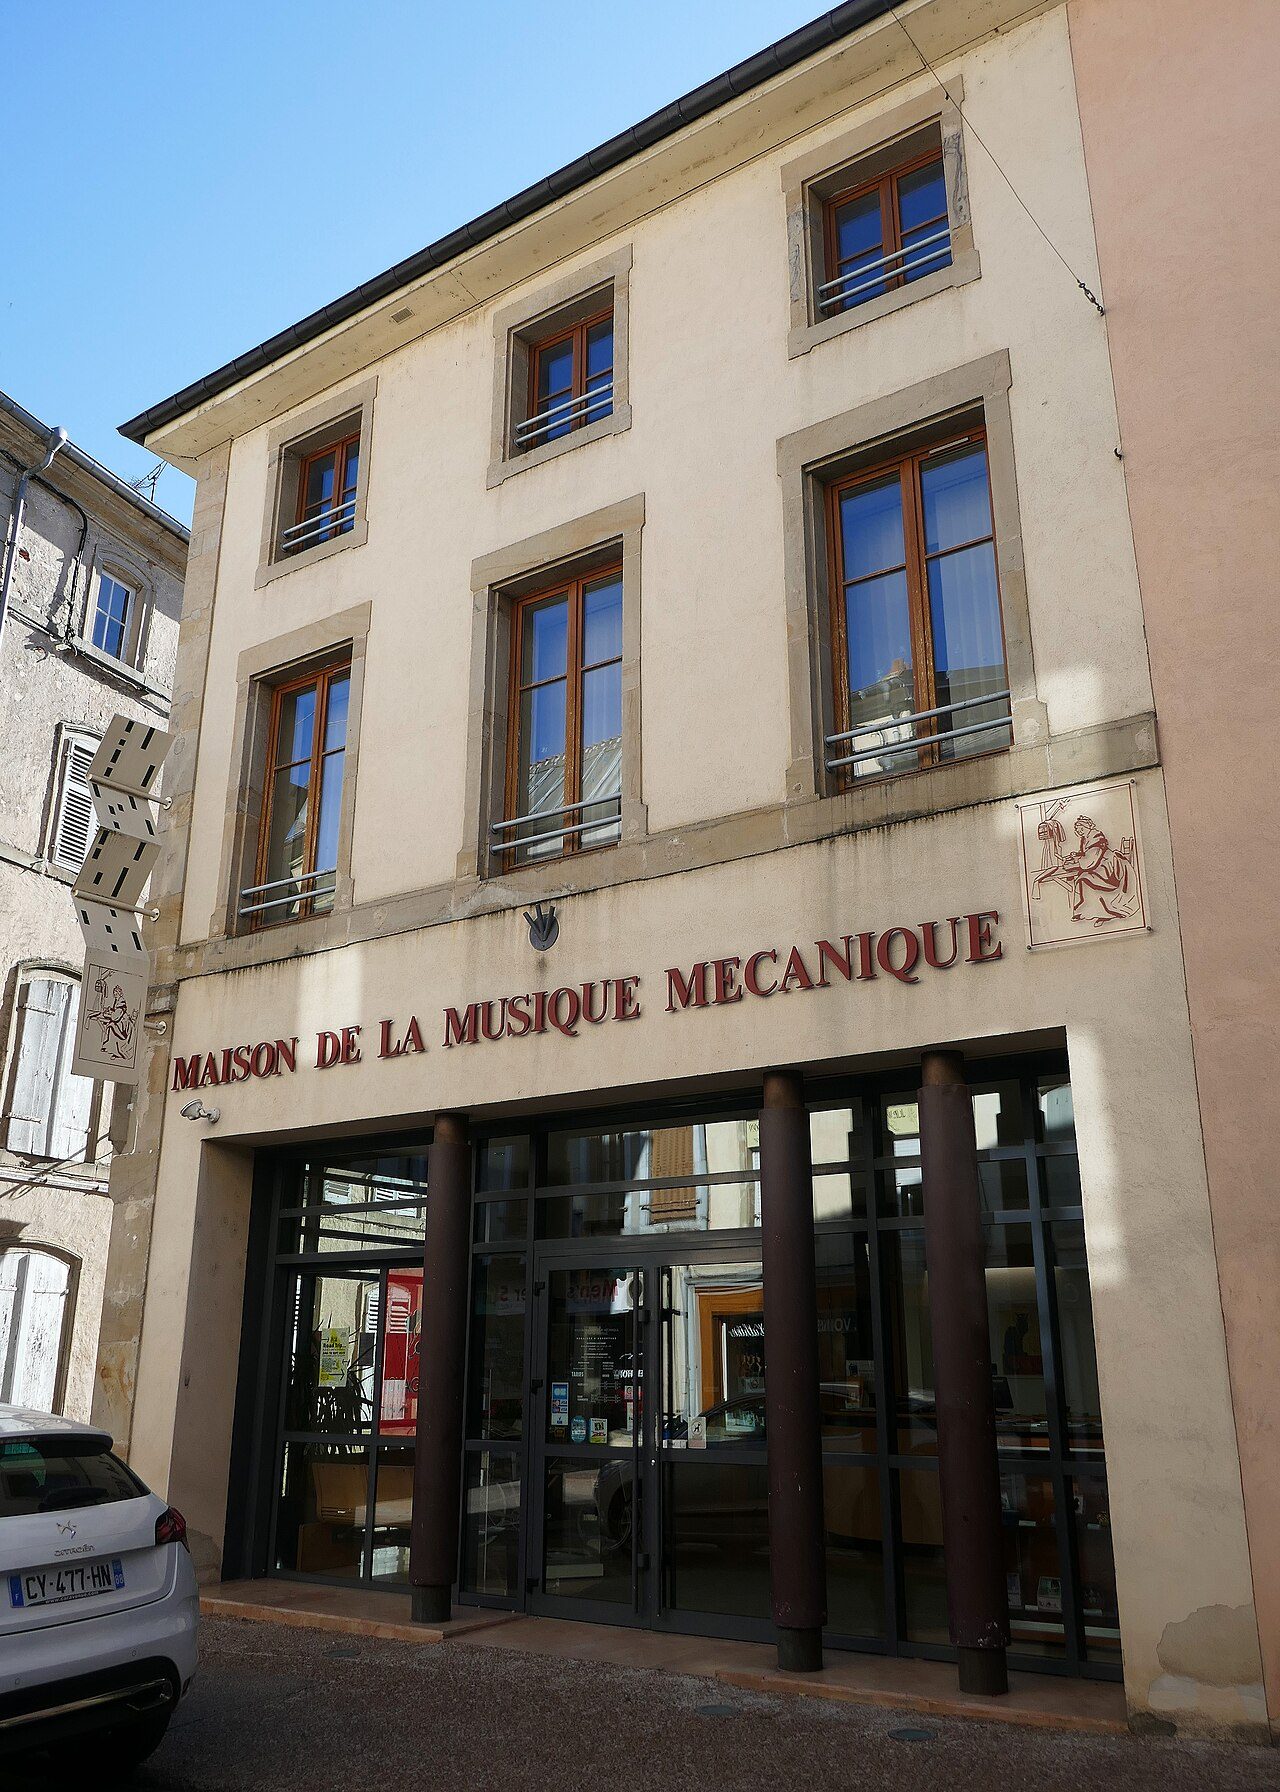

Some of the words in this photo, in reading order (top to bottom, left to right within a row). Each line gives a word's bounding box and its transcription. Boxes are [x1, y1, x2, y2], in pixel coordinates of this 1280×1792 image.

[171, 1036, 299, 1091] MAISON
[314, 1026, 362, 1069] DE
[377, 1015, 425, 1058] LA
[442, 975, 641, 1049] MUSIQUE
[664, 910, 1003, 1012] MECANIQUE
